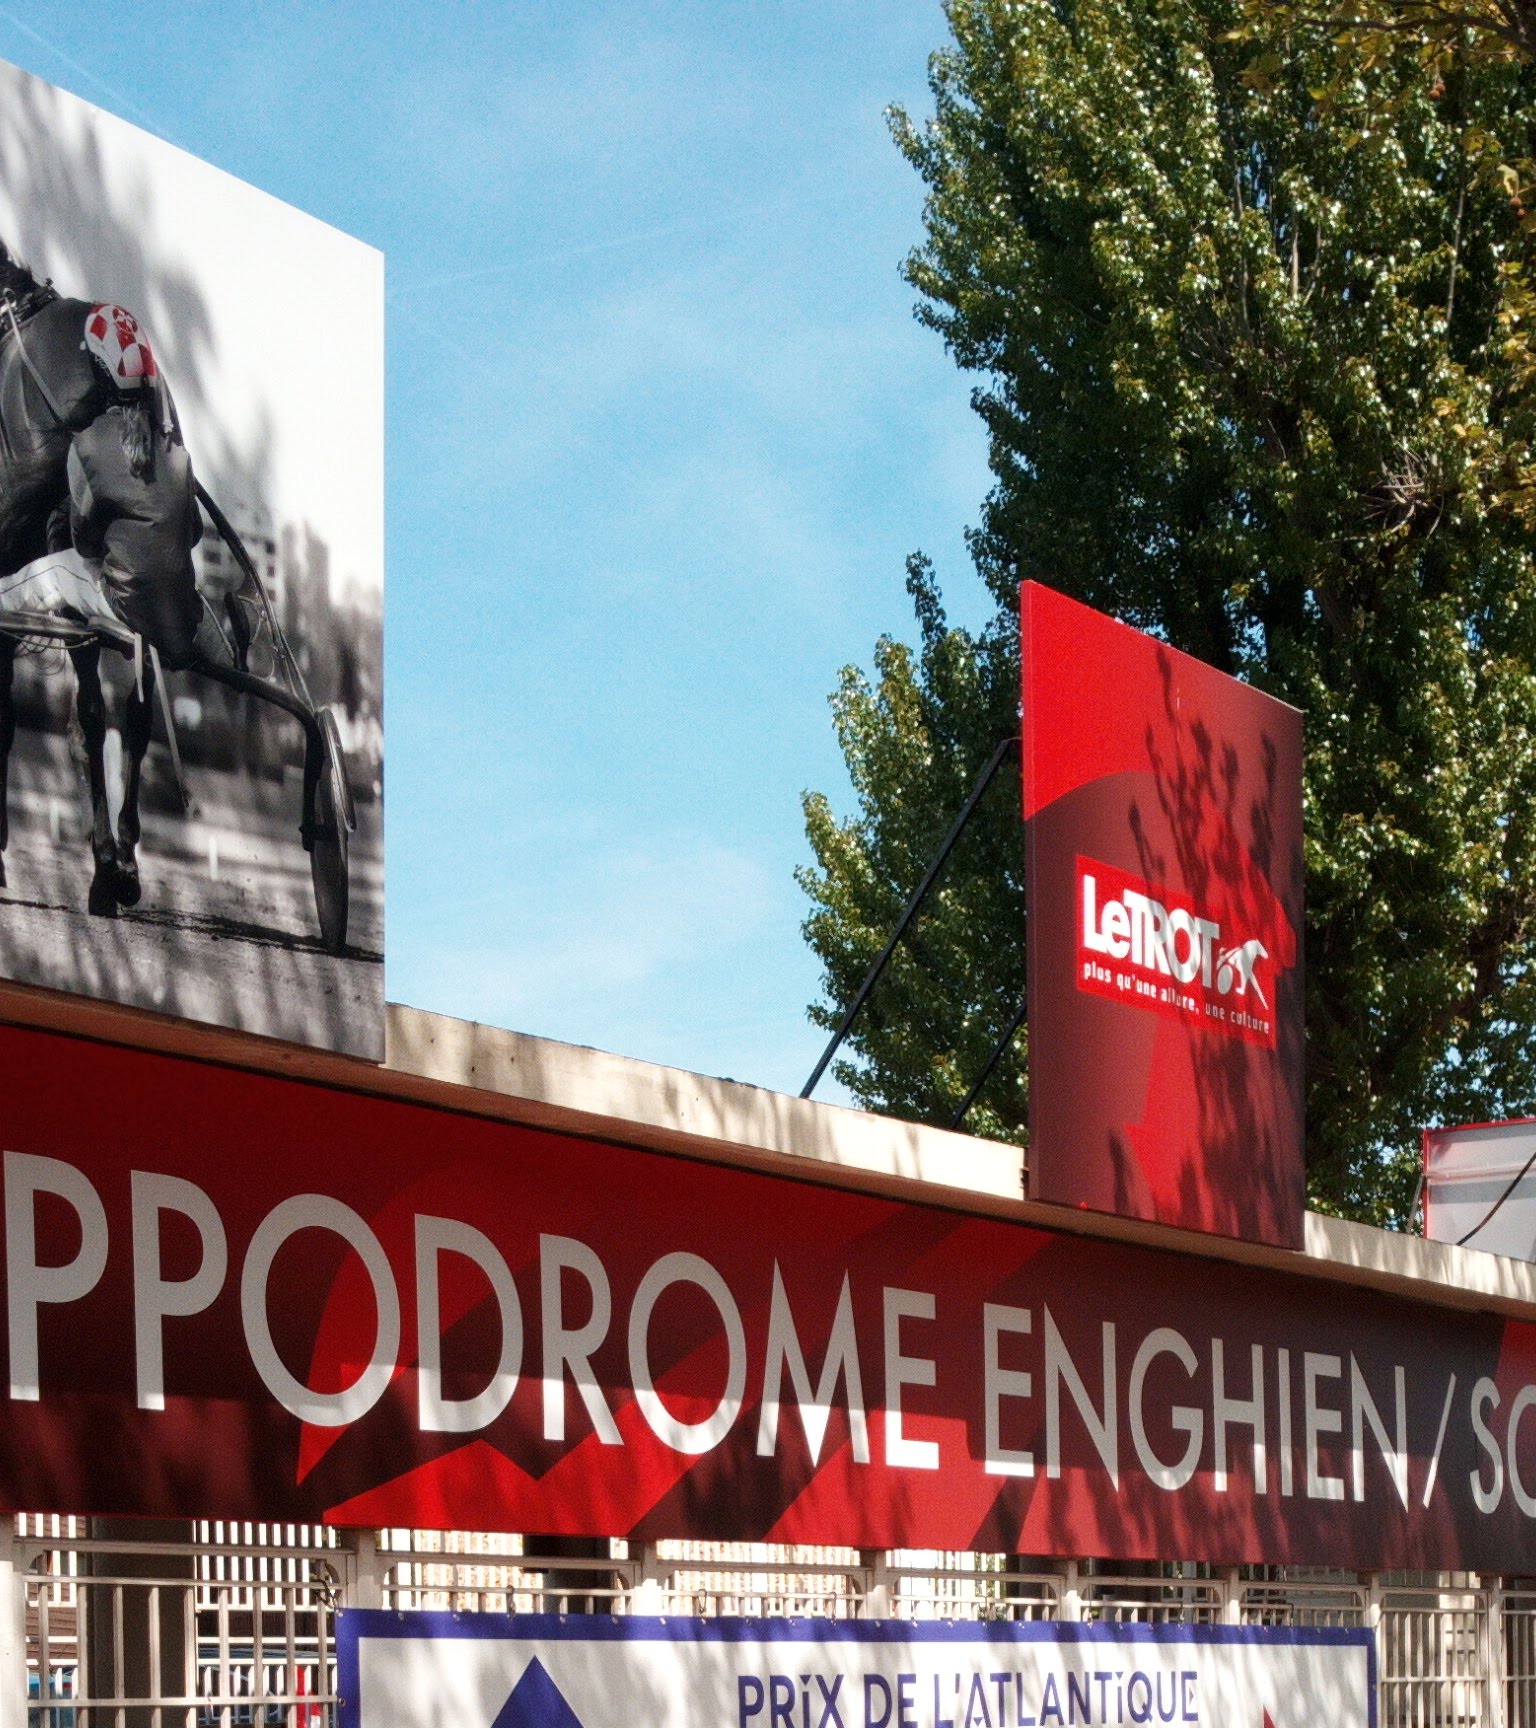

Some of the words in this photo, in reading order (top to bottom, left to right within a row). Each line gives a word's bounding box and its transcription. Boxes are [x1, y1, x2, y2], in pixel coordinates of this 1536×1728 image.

[1083, 961, 1112, 984] plus
[1116, 972, 1157, 999] qu'une
[1160, 987, 1200, 1015] allure,
[1204, 1003, 1225, 1021] une
[1230, 1009, 1270, 1034] culture
